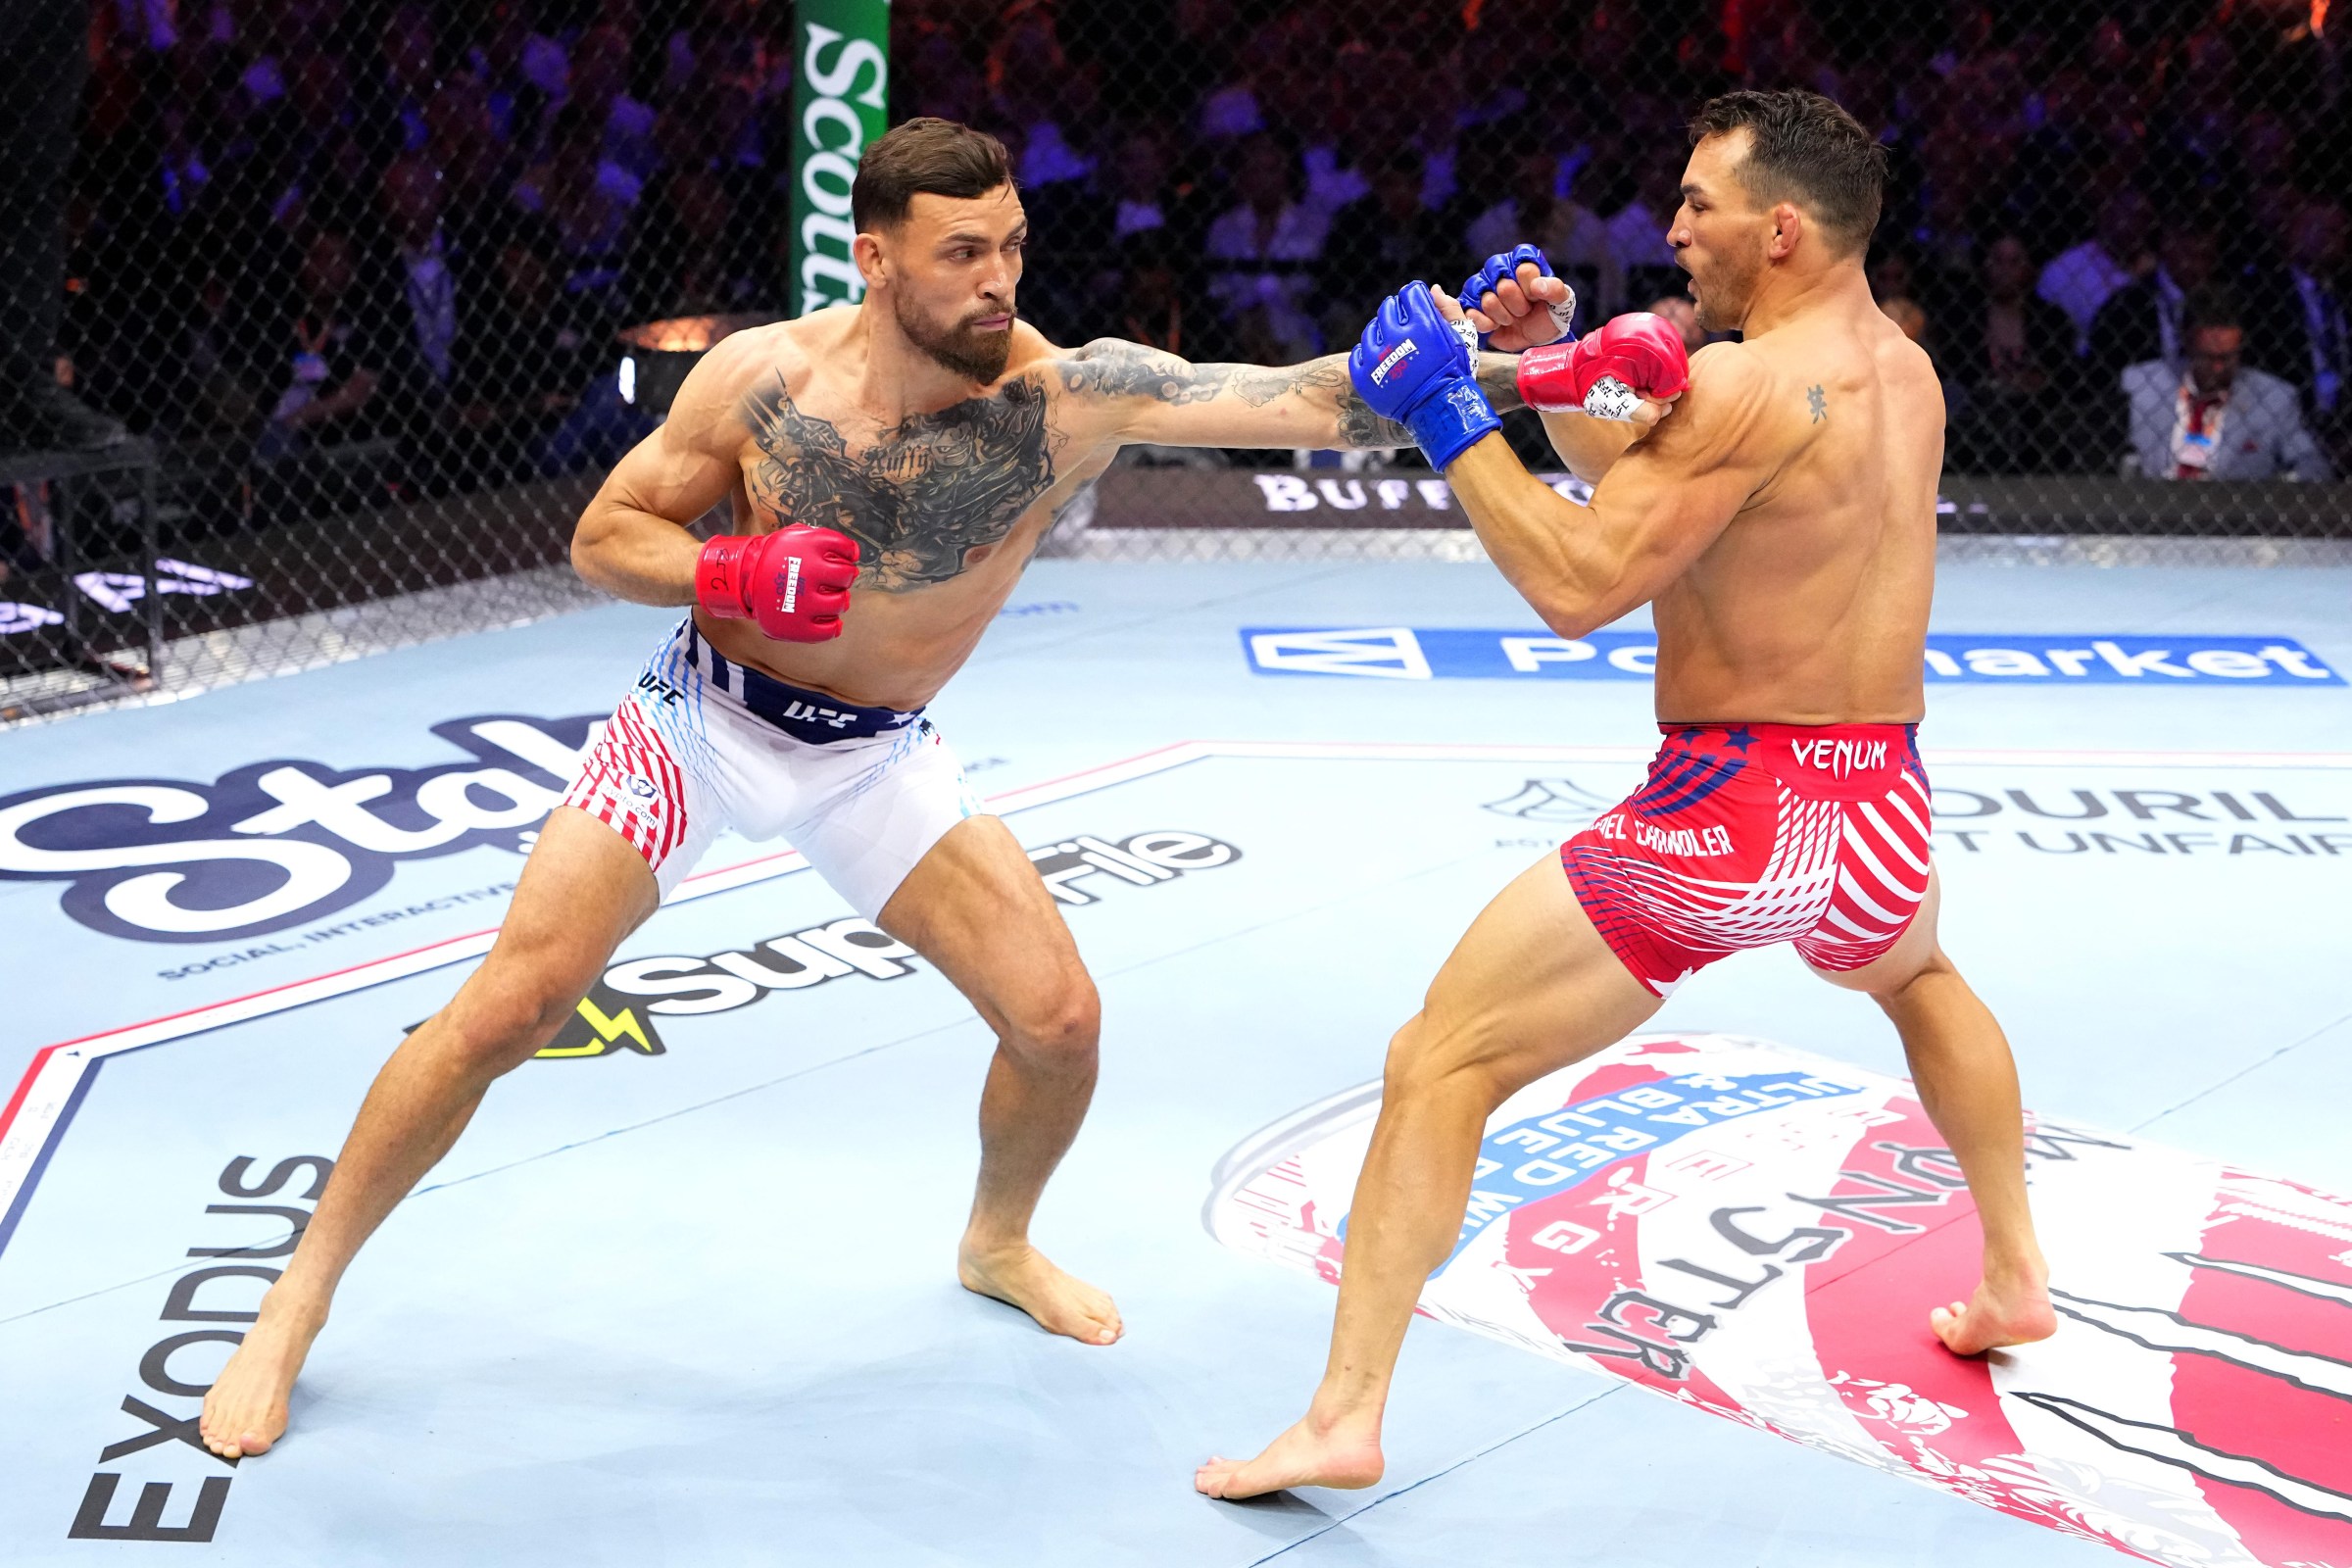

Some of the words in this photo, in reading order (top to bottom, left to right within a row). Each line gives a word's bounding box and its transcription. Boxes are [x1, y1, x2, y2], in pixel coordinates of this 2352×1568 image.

[1371, 338, 1417, 386] FREEDOM
[781, 556, 802, 613] FREEDOM
[638, 671, 684, 707] UFC
[783, 700, 858, 729] UFC
[1790, 738, 1887, 781] VENUM
[599, 784, 656, 827] crypto.com
[1931, 788, 2349, 821] DURIL
[1634, 824, 1734, 858] CHANDLER
[1646, 1076, 1859, 1126] ULTRA
[1673, 1073, 1740, 1091] &
[1492, 1086, 1686, 1155] BLUE
[1512, 1125, 1661, 1186] RED
[68, 1153, 341, 1543] EXODUS
